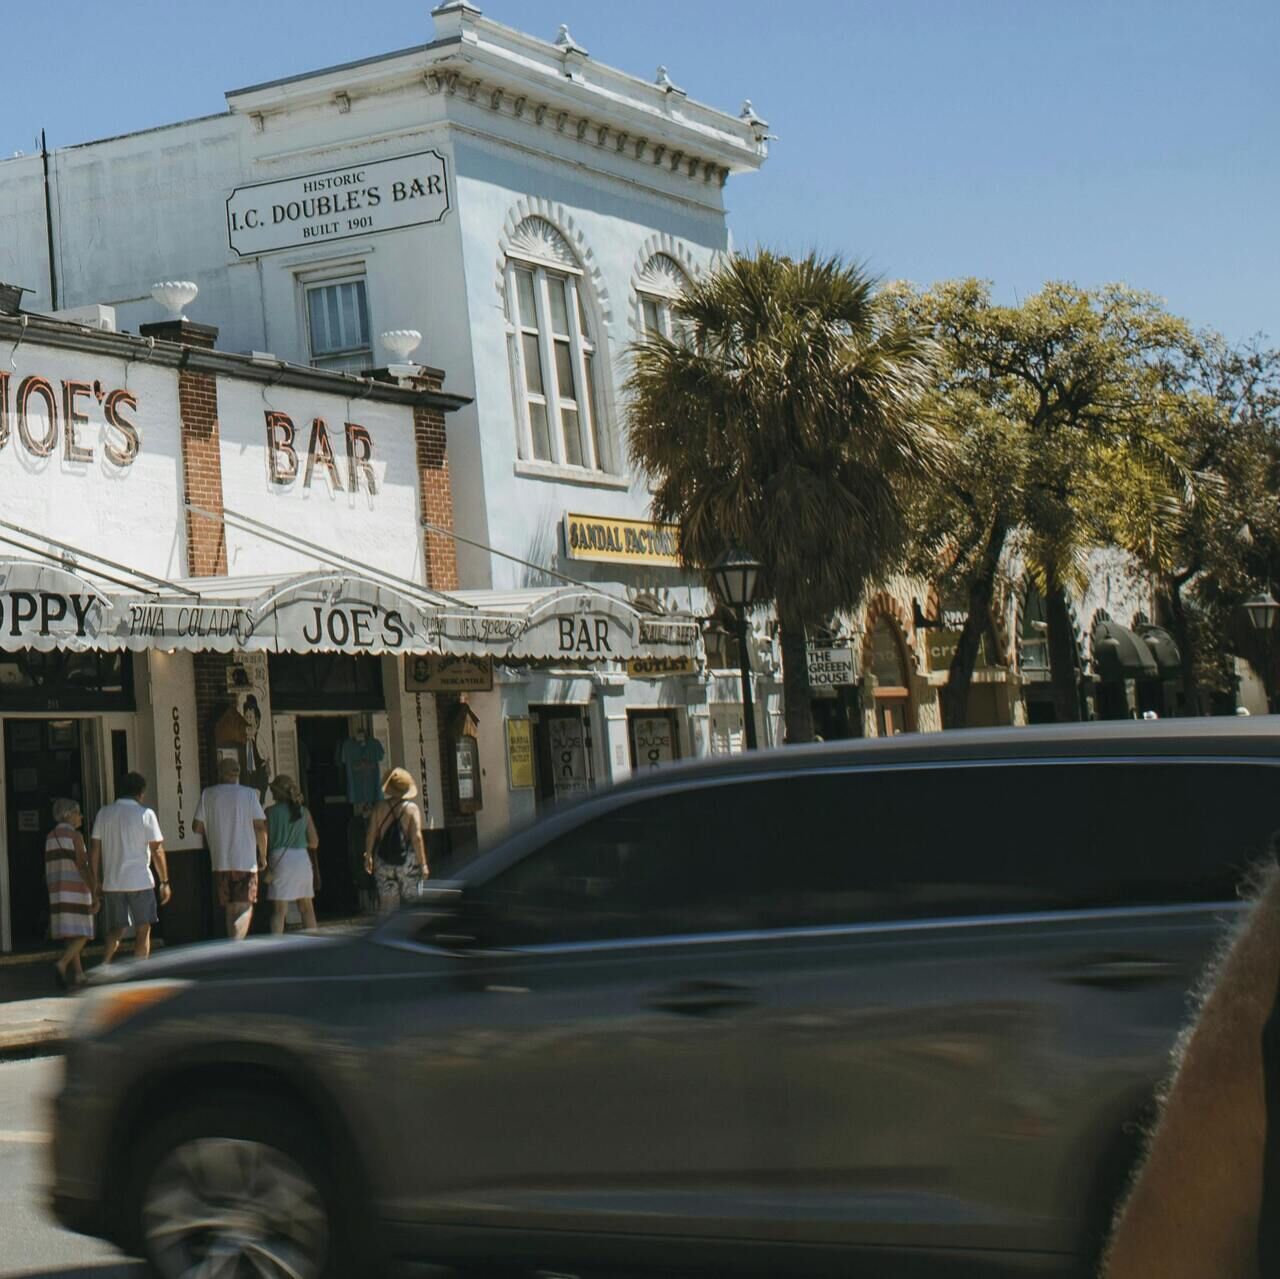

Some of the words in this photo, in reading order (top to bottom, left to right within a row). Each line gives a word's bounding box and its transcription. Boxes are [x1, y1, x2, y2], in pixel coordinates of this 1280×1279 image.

[302, 171, 366, 193] HISTORIC
[230, 208, 265, 232] I.C.
[271, 186, 381, 224] DOUBLE'S
[391, 173, 444, 202] BAR
[302, 221, 340, 239] BUILT
[347, 215, 374, 231] 1901
[263, 410, 379, 496] BAR
[569, 522, 623, 552] SANDAL
[623, 527, 679, 557] FACTORY
[303, 604, 406, 648] JOE'S
[557, 615, 612, 653] BAR
[633, 657, 689, 673] OUTLET
[807, 651, 832, 662] THE
[809, 672, 849, 684] HOUSE
[172, 706, 186, 840] COCKTAILS
